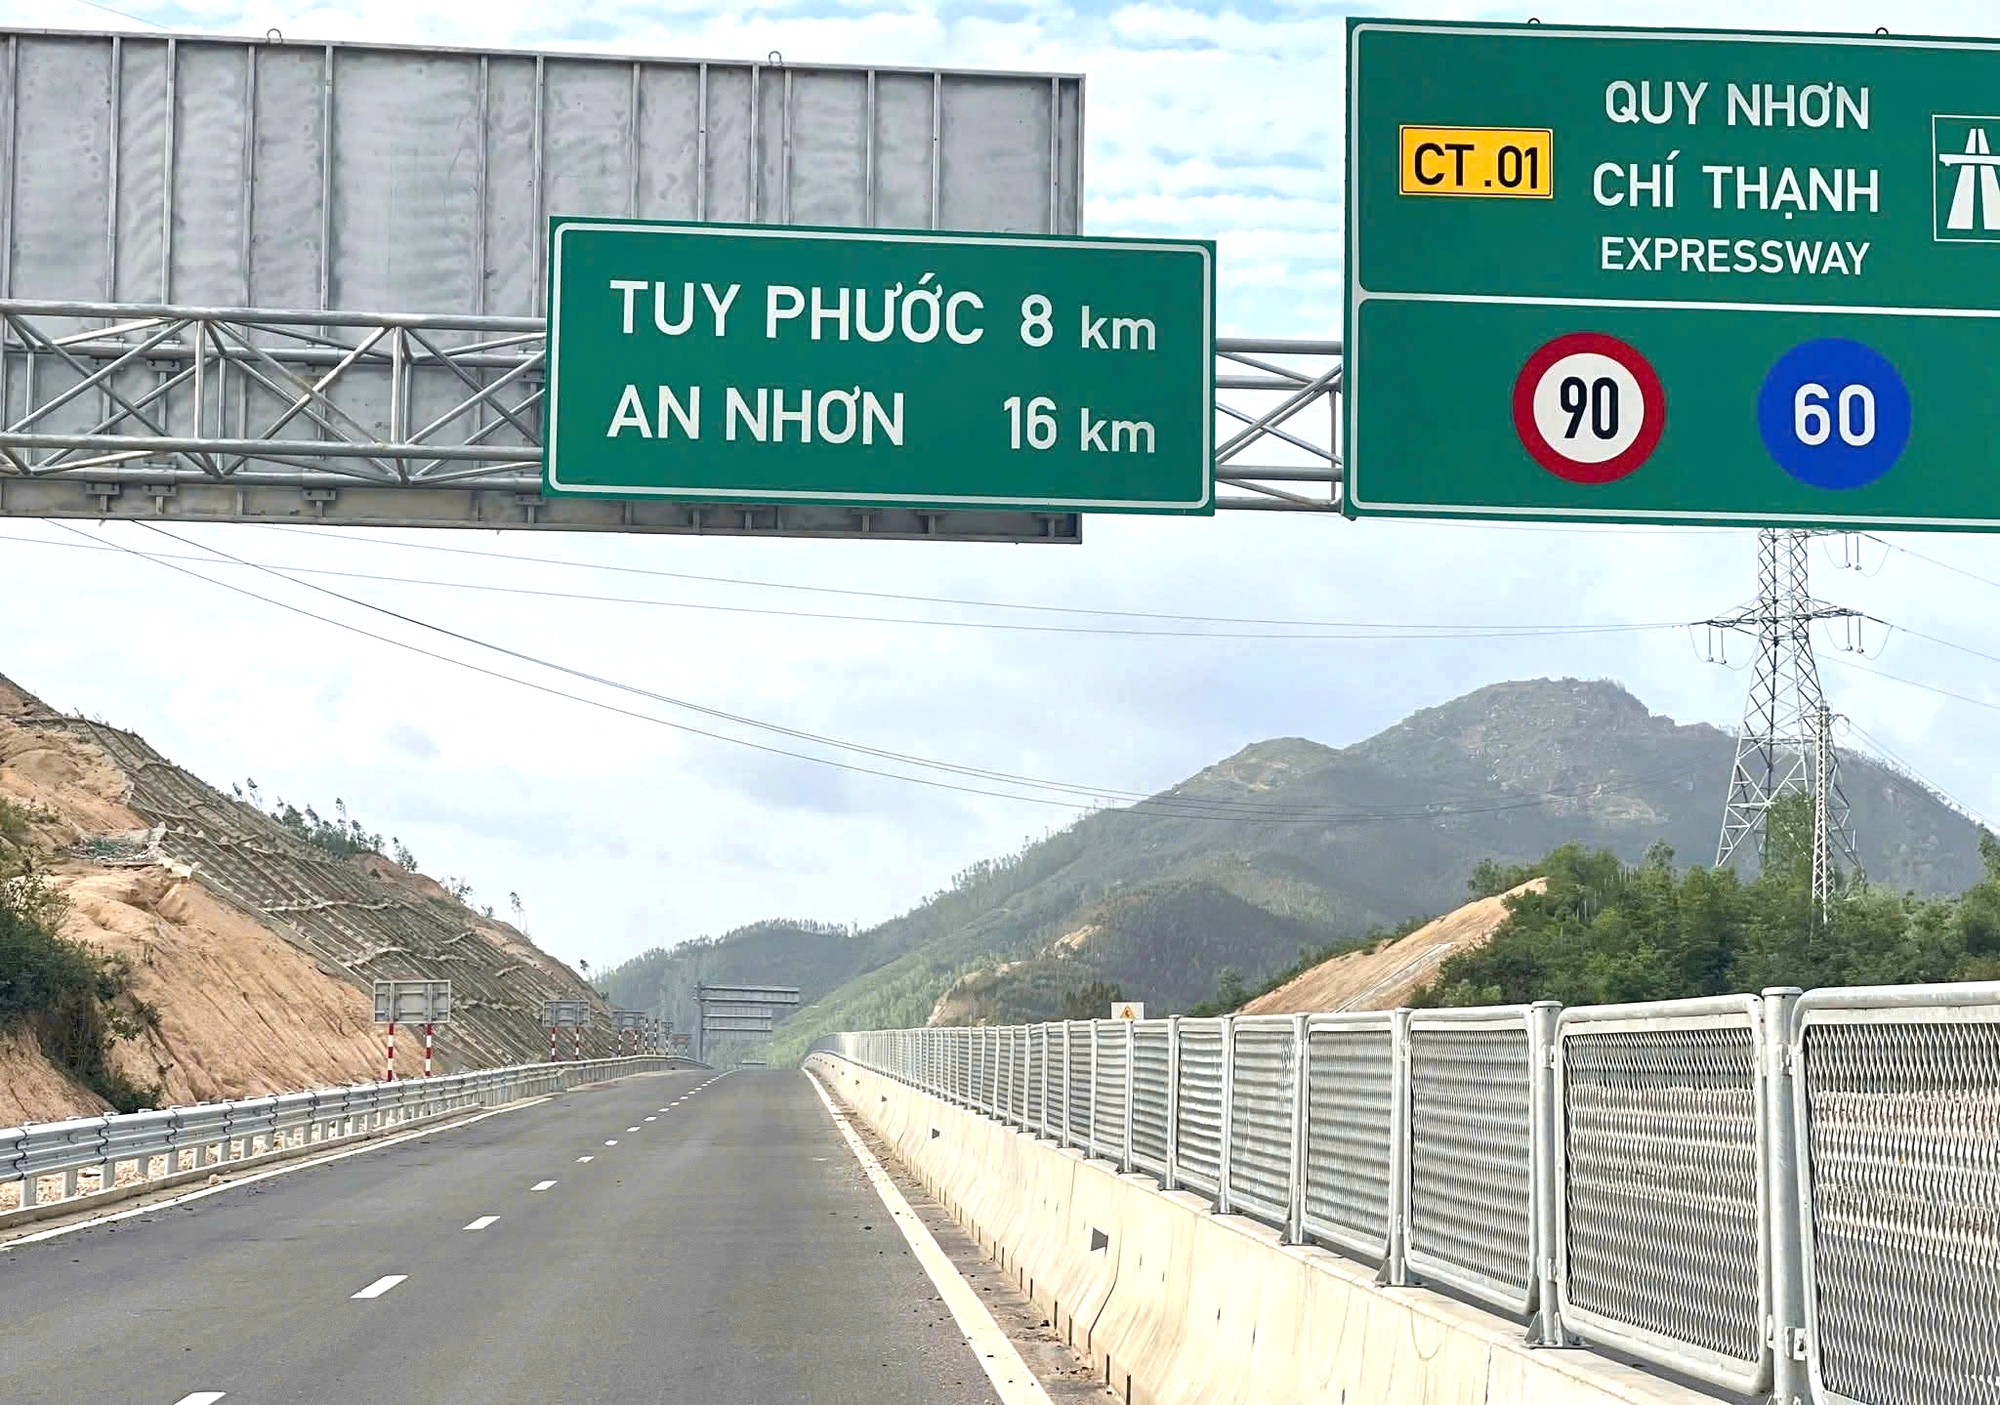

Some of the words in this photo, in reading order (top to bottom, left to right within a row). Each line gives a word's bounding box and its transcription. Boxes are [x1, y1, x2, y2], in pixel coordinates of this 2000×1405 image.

[1605, 80, 1709, 130] QUY
[1727, 80, 1870, 130] NHƠN
[1593, 149, 1681, 208] CHÍ
[1702, 165, 1879, 220] THẠNH
[1601, 236, 1871, 275] EXPRESSWAY
[609, 279, 742, 337] TUY
[766, 272, 985, 346] PHƯỚC
[1020, 294, 1055, 347] 8
[1081, 305, 1157, 350] km
[606, 384, 701, 439] AN
[726, 385, 905, 446] NHƠN
[1003, 396, 1058, 450] 16
[1080, 407, 1156, 453] km
[1560, 376, 1620, 440] 90
[1794, 383, 1877, 447] 60
